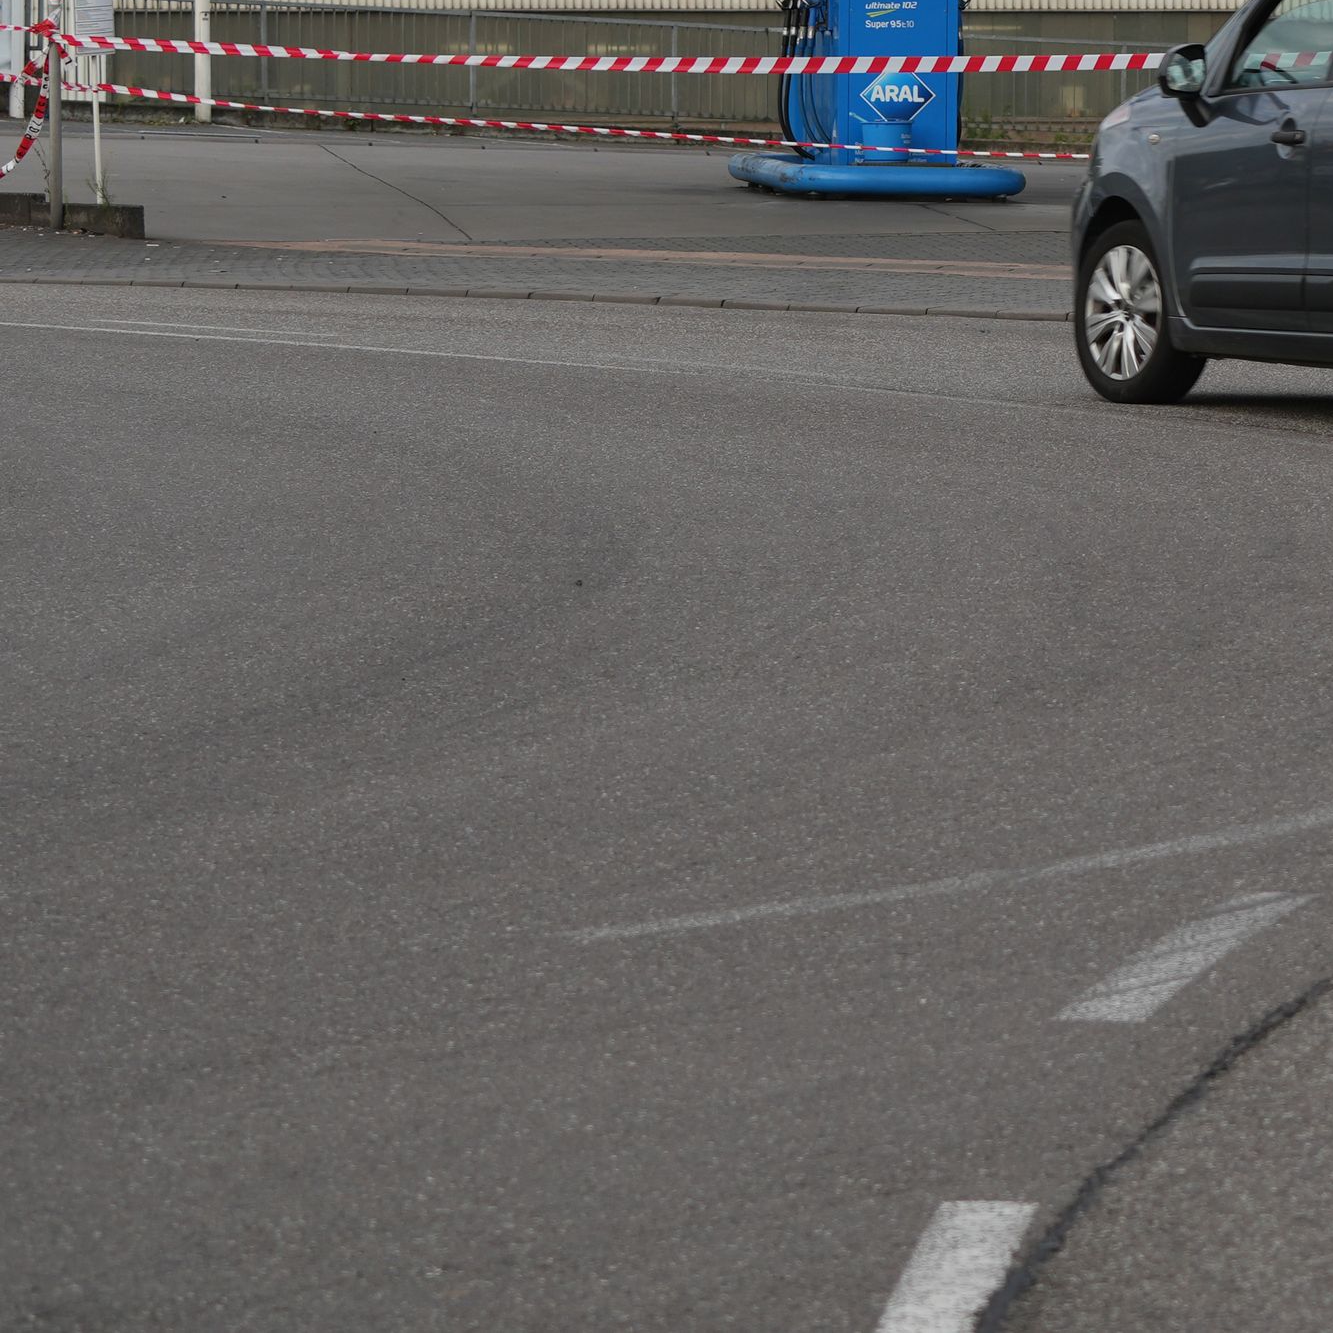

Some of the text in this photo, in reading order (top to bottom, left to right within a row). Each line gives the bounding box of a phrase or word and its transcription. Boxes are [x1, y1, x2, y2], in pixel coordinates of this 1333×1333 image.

[865, 1, 918, 9] ultimate 102
[865, 20, 889, 29] Super
[870, 84, 925, 103] ARAL
